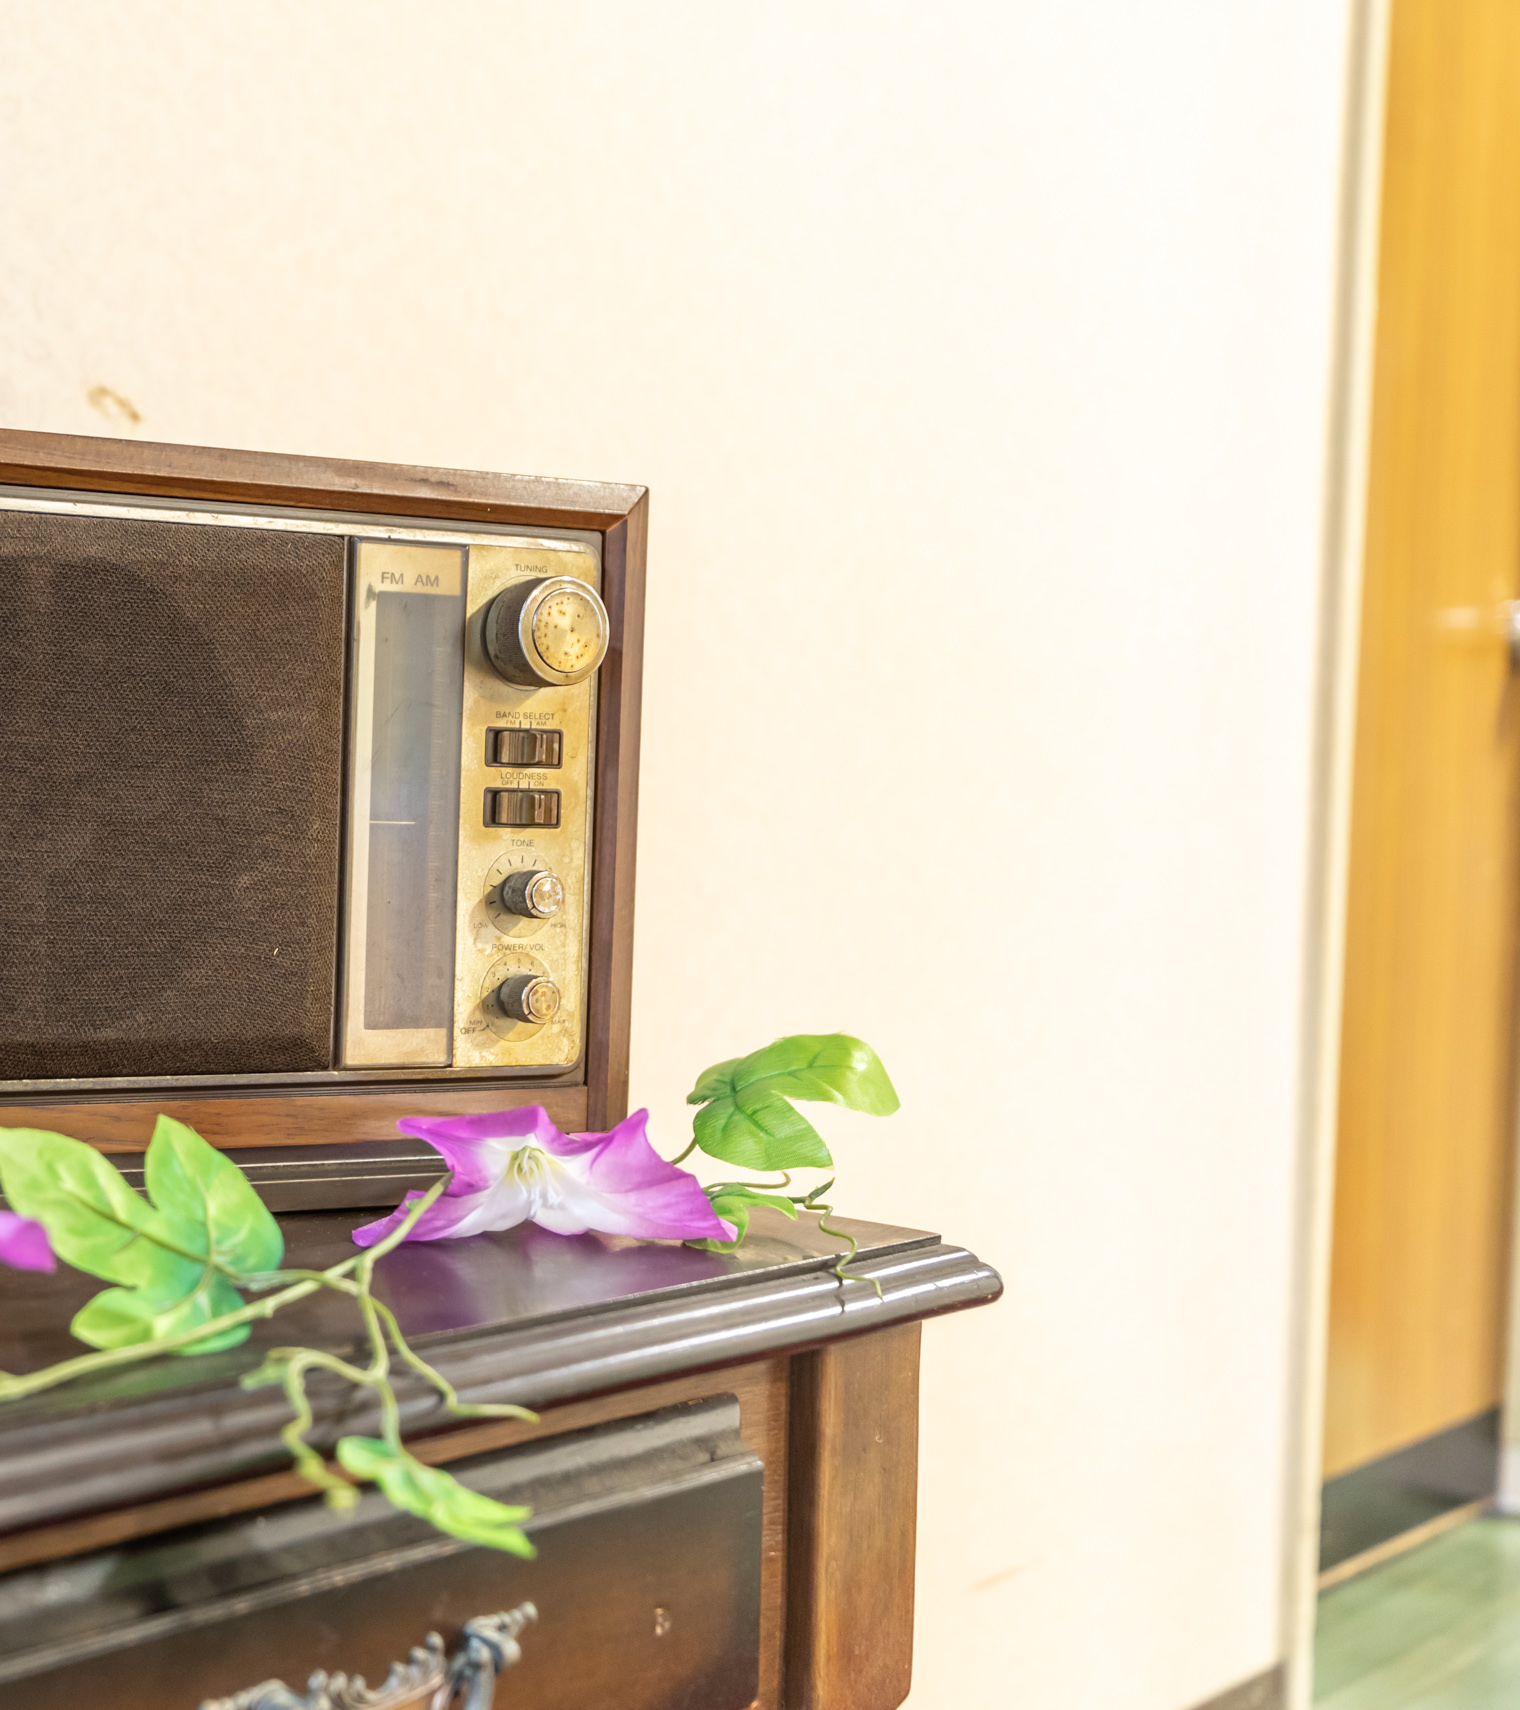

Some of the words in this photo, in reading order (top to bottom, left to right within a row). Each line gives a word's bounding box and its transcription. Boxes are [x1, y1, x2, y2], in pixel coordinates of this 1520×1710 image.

[514, 563, 548, 573] TUNING
[380, 571, 404, 586] FM
[414, 575, 439, 587] AM
[495, 711, 520, 719] BAND
[523, 712, 555, 720] SELECT
[500, 772, 547, 780] LOUDNESS
[511, 839, 534, 847] TONE
[492, 944, 545, 952] POWER/VOL
[460, 1027, 478, 1035] OFF
